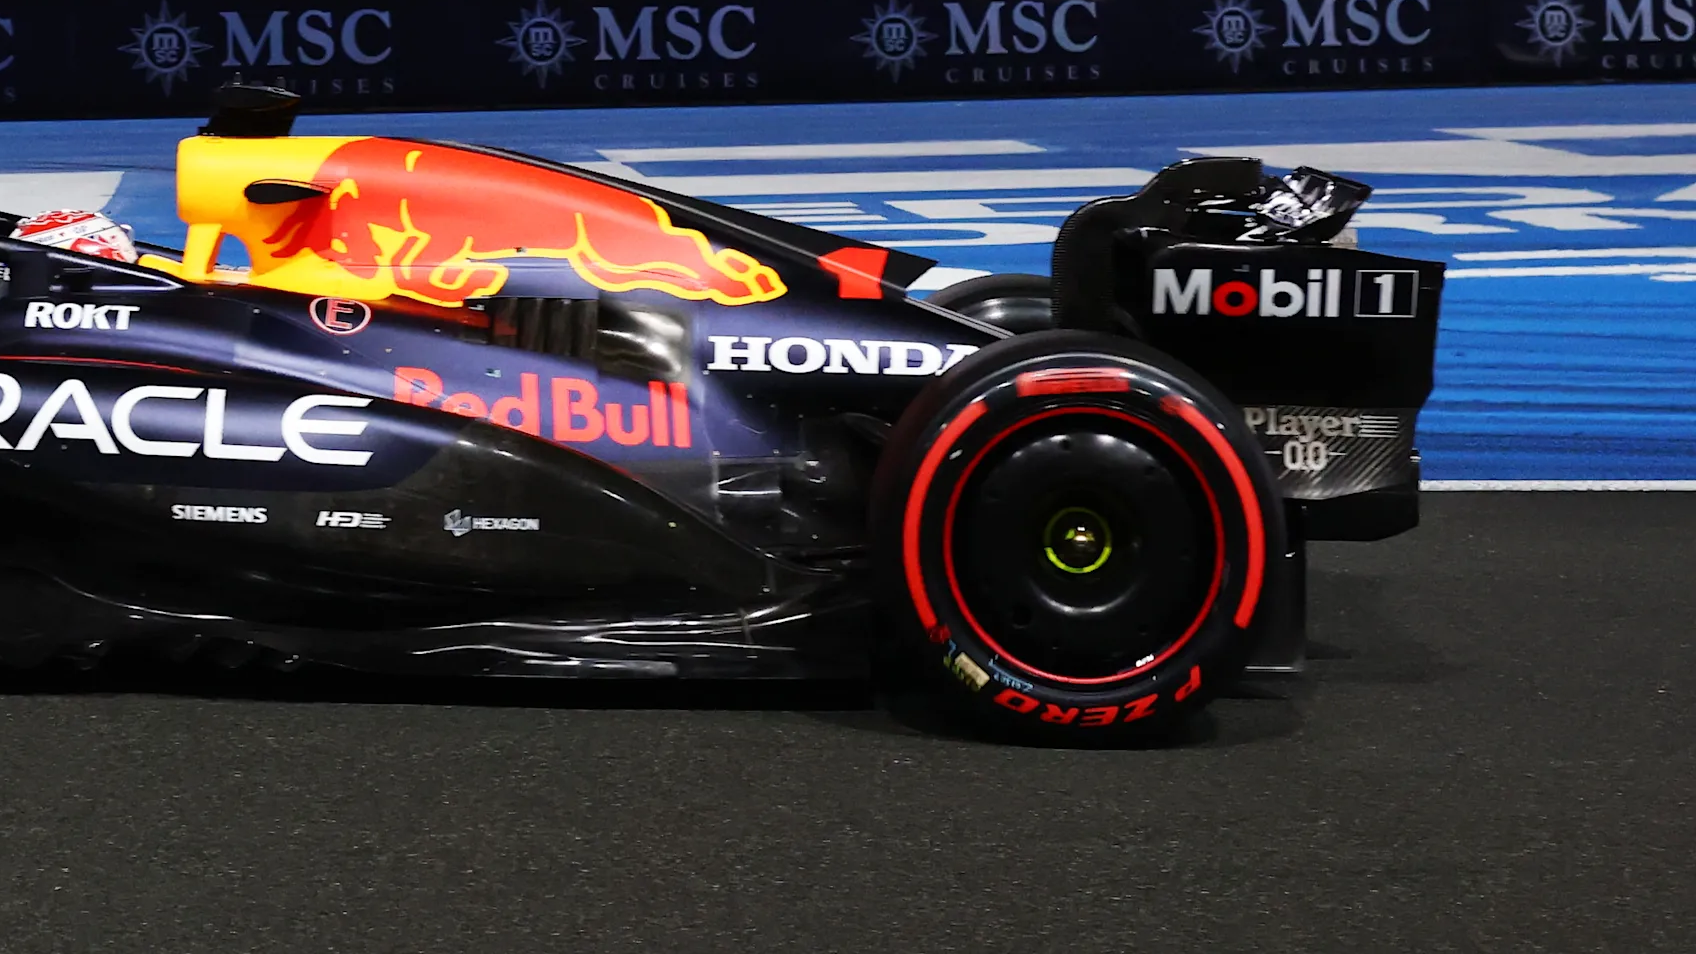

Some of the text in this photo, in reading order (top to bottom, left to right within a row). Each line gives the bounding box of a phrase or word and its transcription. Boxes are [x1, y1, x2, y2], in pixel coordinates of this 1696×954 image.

[219, 8, 392, 66] MSC
[592, 4, 756, 61] MSC
[943, 0, 1097, 56] MSC
[945, 65, 1100, 83] CRUISES
[1282, 56, 1433, 75] CRUISES
[1602, 53, 1696, 69] CRUI
[594, 72, 759, 90] CRUISES
[1152, 268, 1396, 317] Mobil 1
[25, 302, 140, 331] ROKT
[325, 298, 355, 329] E
[551, 377, 692, 448] Bull
[1243, 406, 1359, 443] Player
[171, 504, 268, 524] SIEMENS
[992, 664, 1202, 727] P ZERO
